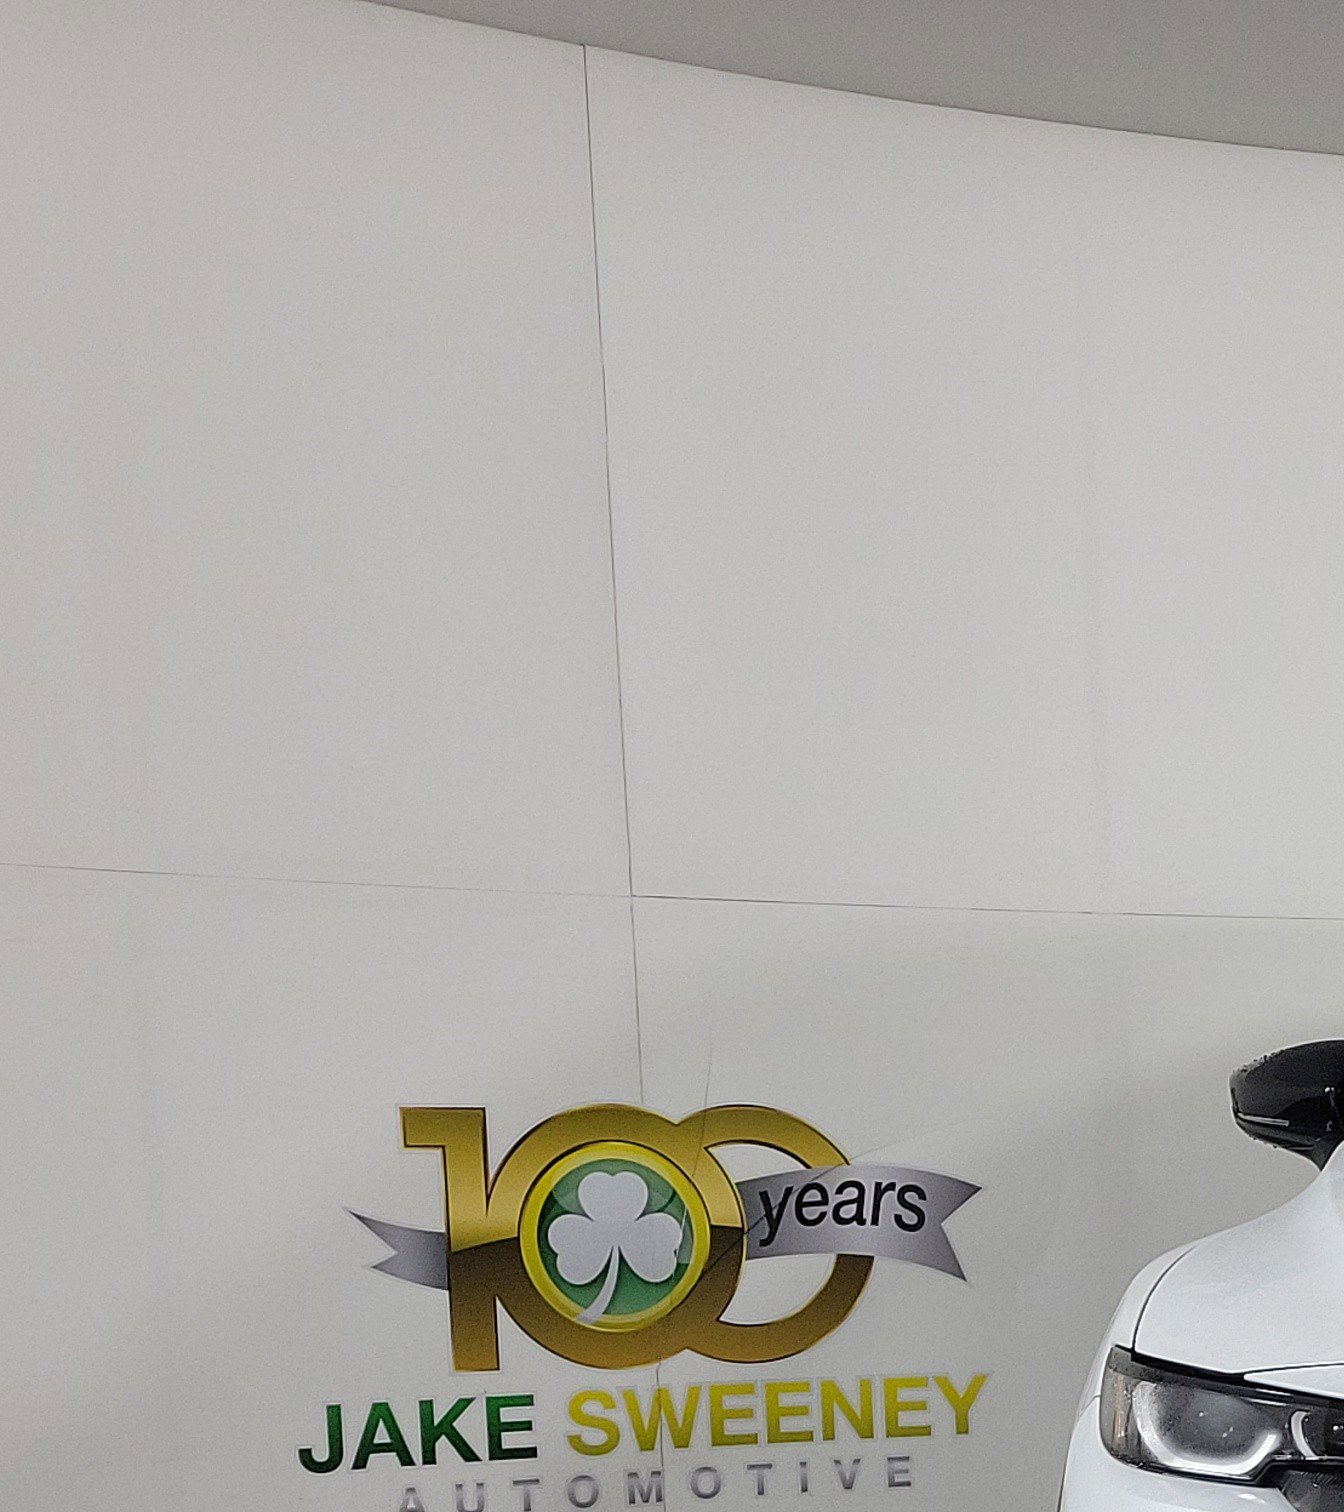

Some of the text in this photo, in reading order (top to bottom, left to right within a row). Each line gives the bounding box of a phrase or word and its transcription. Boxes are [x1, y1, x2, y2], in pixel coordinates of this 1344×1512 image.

[400, 1104, 927, 1372] 100 years
[298, 1373, 988, 1475] JAKE SWEENEY
